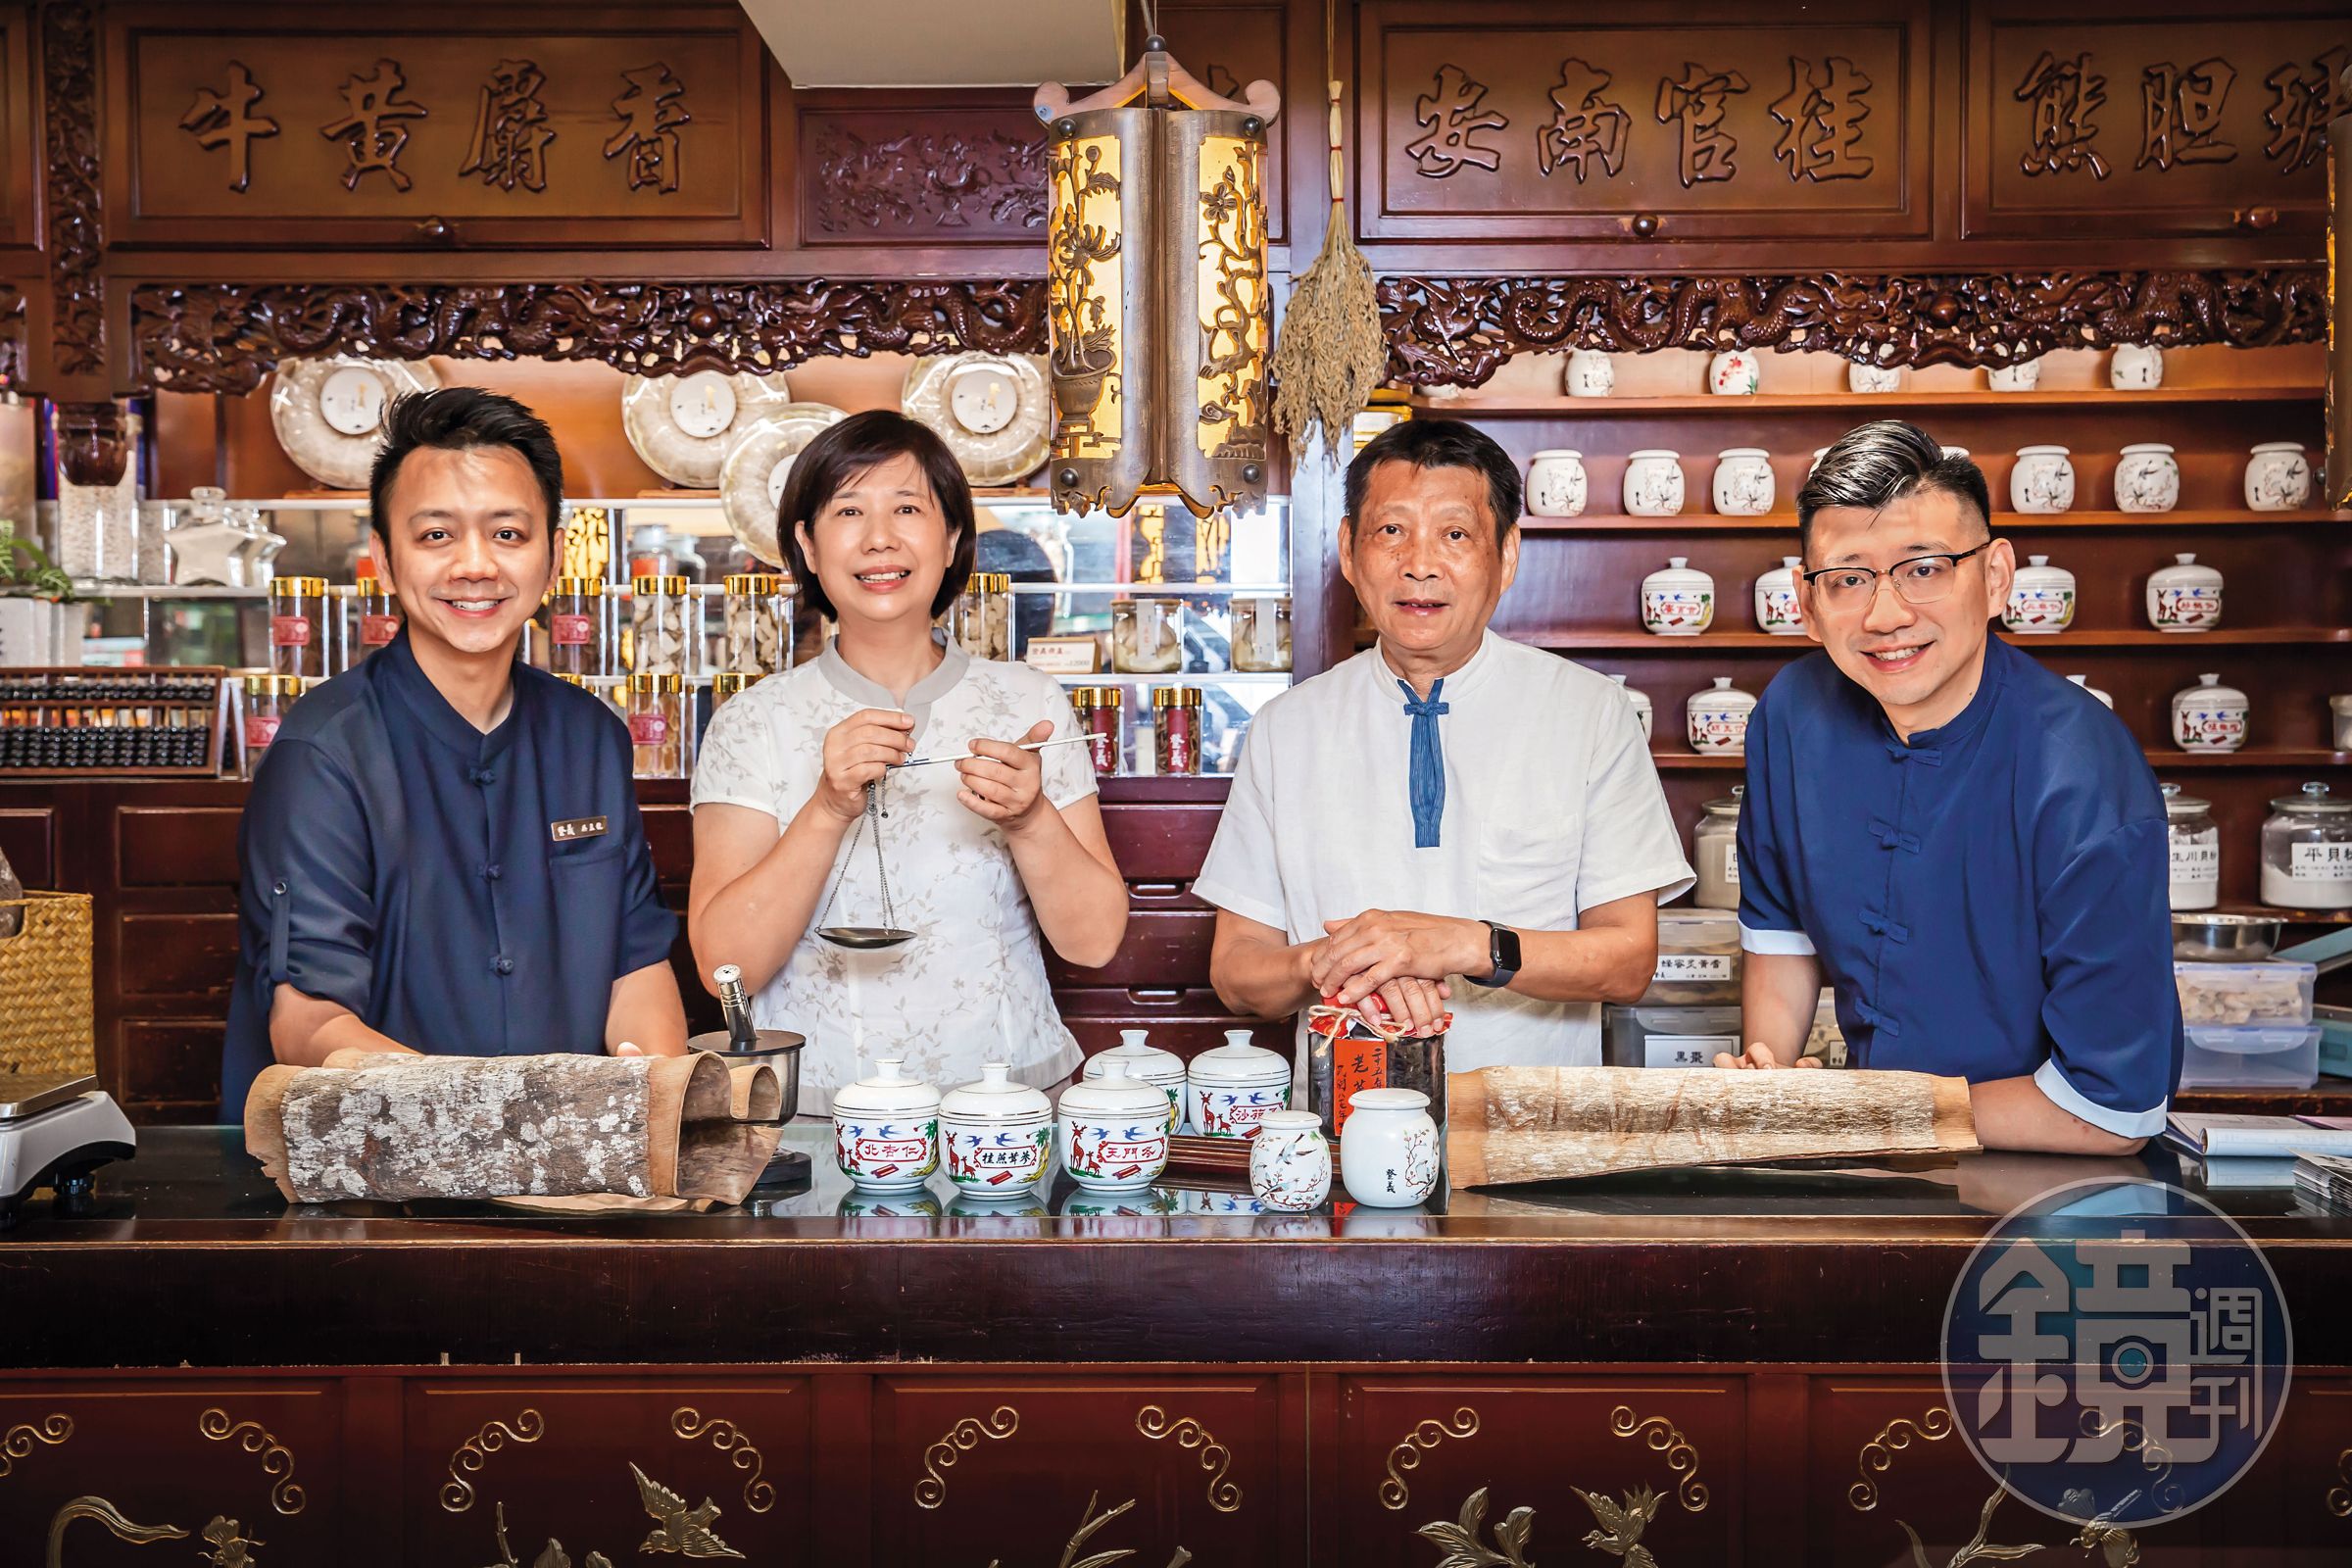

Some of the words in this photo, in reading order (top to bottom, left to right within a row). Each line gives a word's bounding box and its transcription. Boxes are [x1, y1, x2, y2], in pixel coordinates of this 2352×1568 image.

[1406, 54, 1875, 188] 安南官桂
[863, 1144, 920, 1158] 北杏仁
[1105, 1146, 1156, 1159] 天門冬
